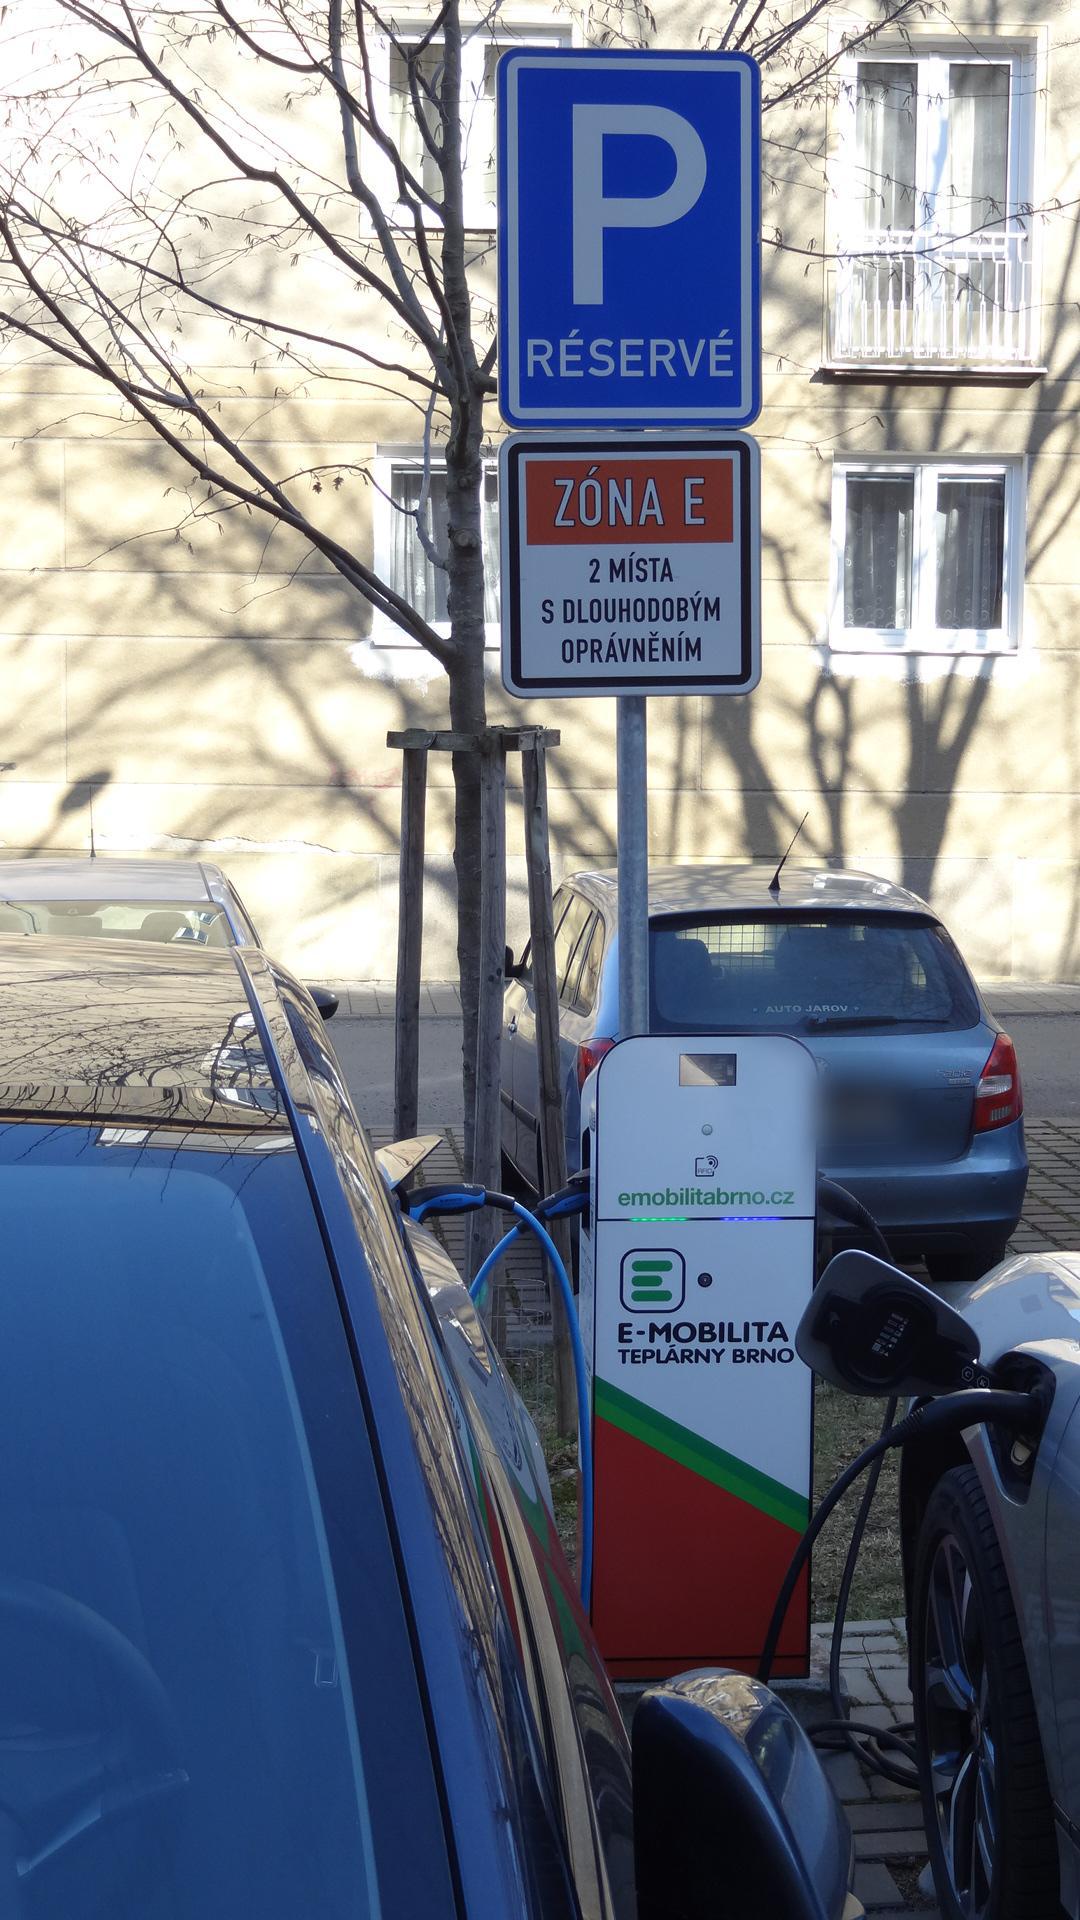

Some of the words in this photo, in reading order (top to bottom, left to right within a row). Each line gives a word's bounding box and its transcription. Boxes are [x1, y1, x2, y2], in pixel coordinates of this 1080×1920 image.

[572, 103, 708, 305] P
[526, 328, 734, 378] RÉSERVÉ
[553, 465, 665, 527] ZÓNA
[683, 476, 706, 526] E
[588, 558, 601, 583] 2
[608, 551, 674, 583] MÍSTA
[541, 598, 555, 624] S
[562, 591, 721, 624] DLOUHODOBÝM
[560, 631, 702, 664] OPRÁVNĚNÍM
[765, 1004, 802, 1014] AUTO
[805, 1004, 849, 1013] JAROV
[617, 1187, 795, 1207] emobilitabrno.cz
[617, 1321, 789, 1344] E-MOBILITA
[617, 1344, 726, 1364] TEPLÁRNY
[732, 1347, 795, 1364] BRNO
